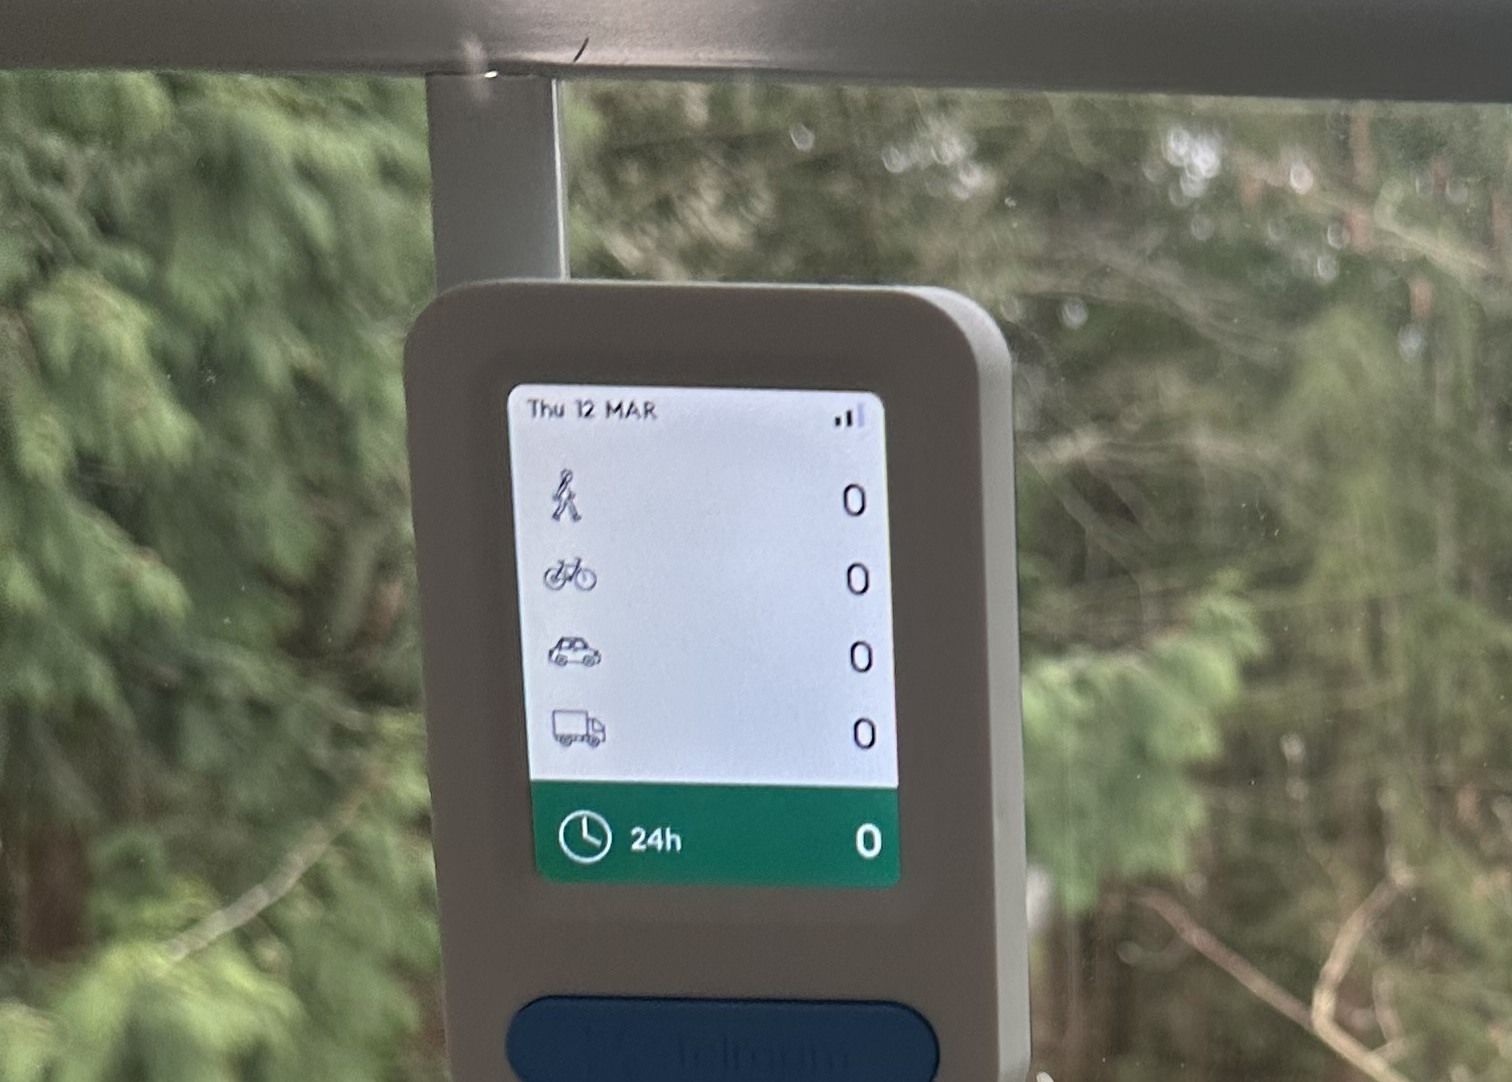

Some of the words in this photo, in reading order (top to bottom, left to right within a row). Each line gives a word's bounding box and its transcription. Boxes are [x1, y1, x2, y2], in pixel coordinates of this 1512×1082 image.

[527, 398, 565, 419] Thu
[575, 399, 596, 419] 12
[604, 400, 657, 421] MAR
[842, 483, 867, 518] 0
[846, 562, 870, 596] 0
[849, 640, 873, 673] 0
[853, 717, 876, 750] 0
[629, 825, 683, 854] 24h
[855, 822, 882, 859] 0
